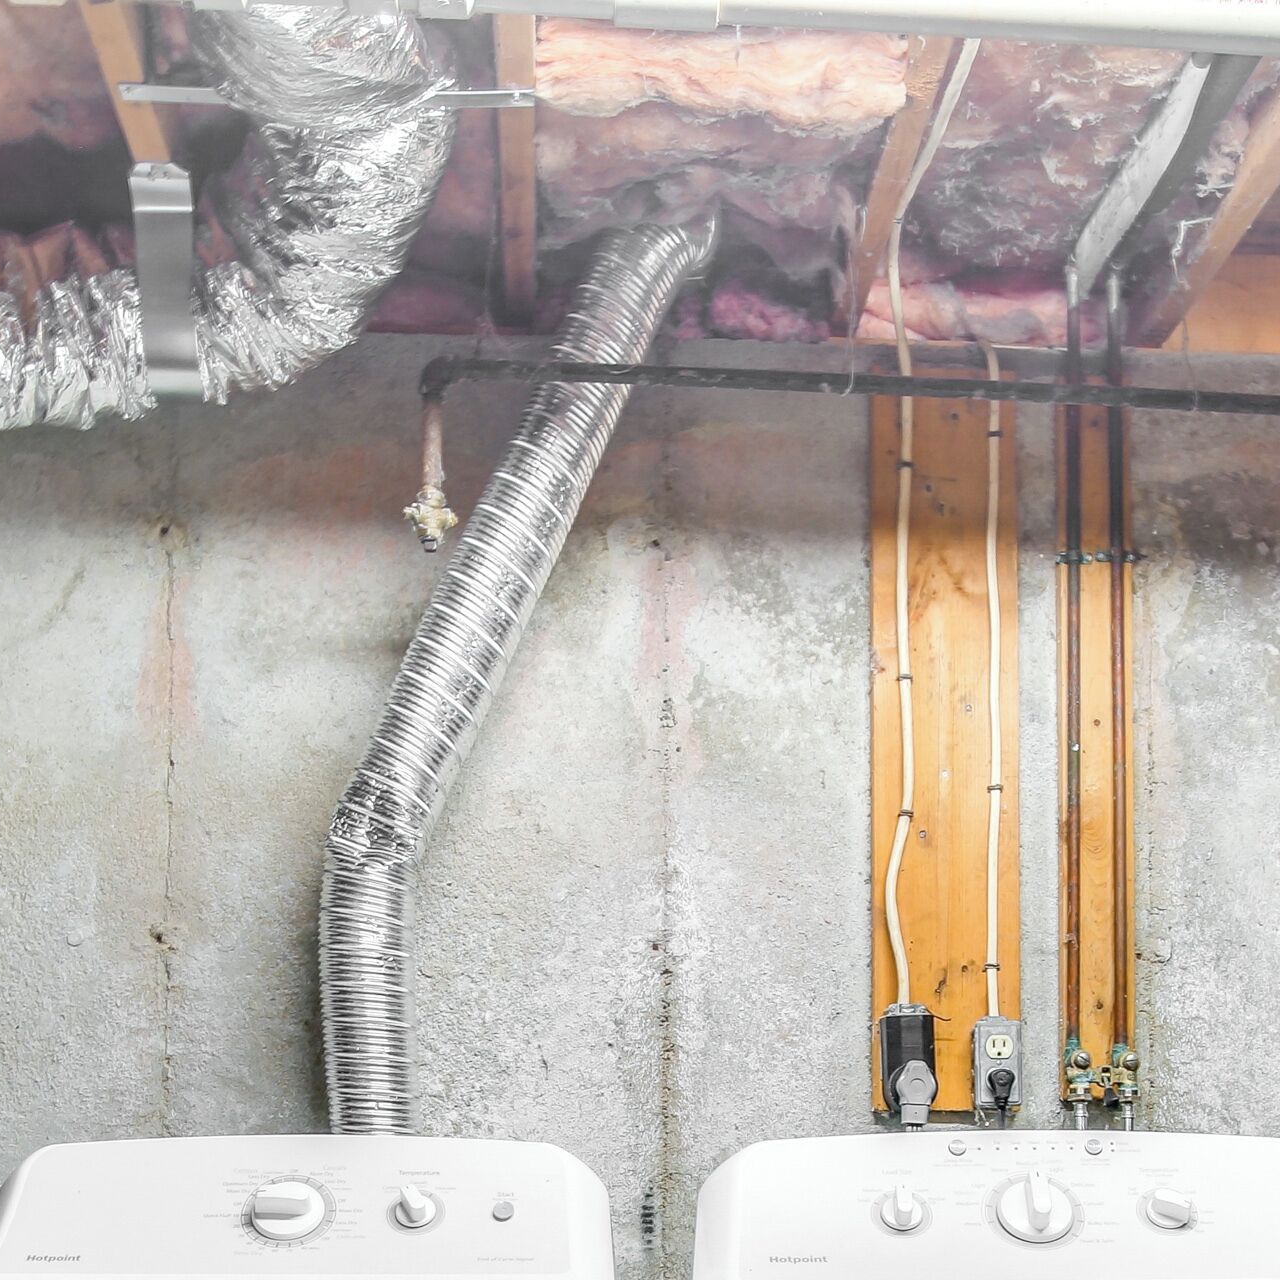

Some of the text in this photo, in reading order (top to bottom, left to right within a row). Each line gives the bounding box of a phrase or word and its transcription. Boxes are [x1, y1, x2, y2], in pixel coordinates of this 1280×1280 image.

[399, 1169, 441, 1177] Temperature
[25, 1254, 81, 1263] Hotpoint
[768, 1255, 829, 1265] Hotpoint
